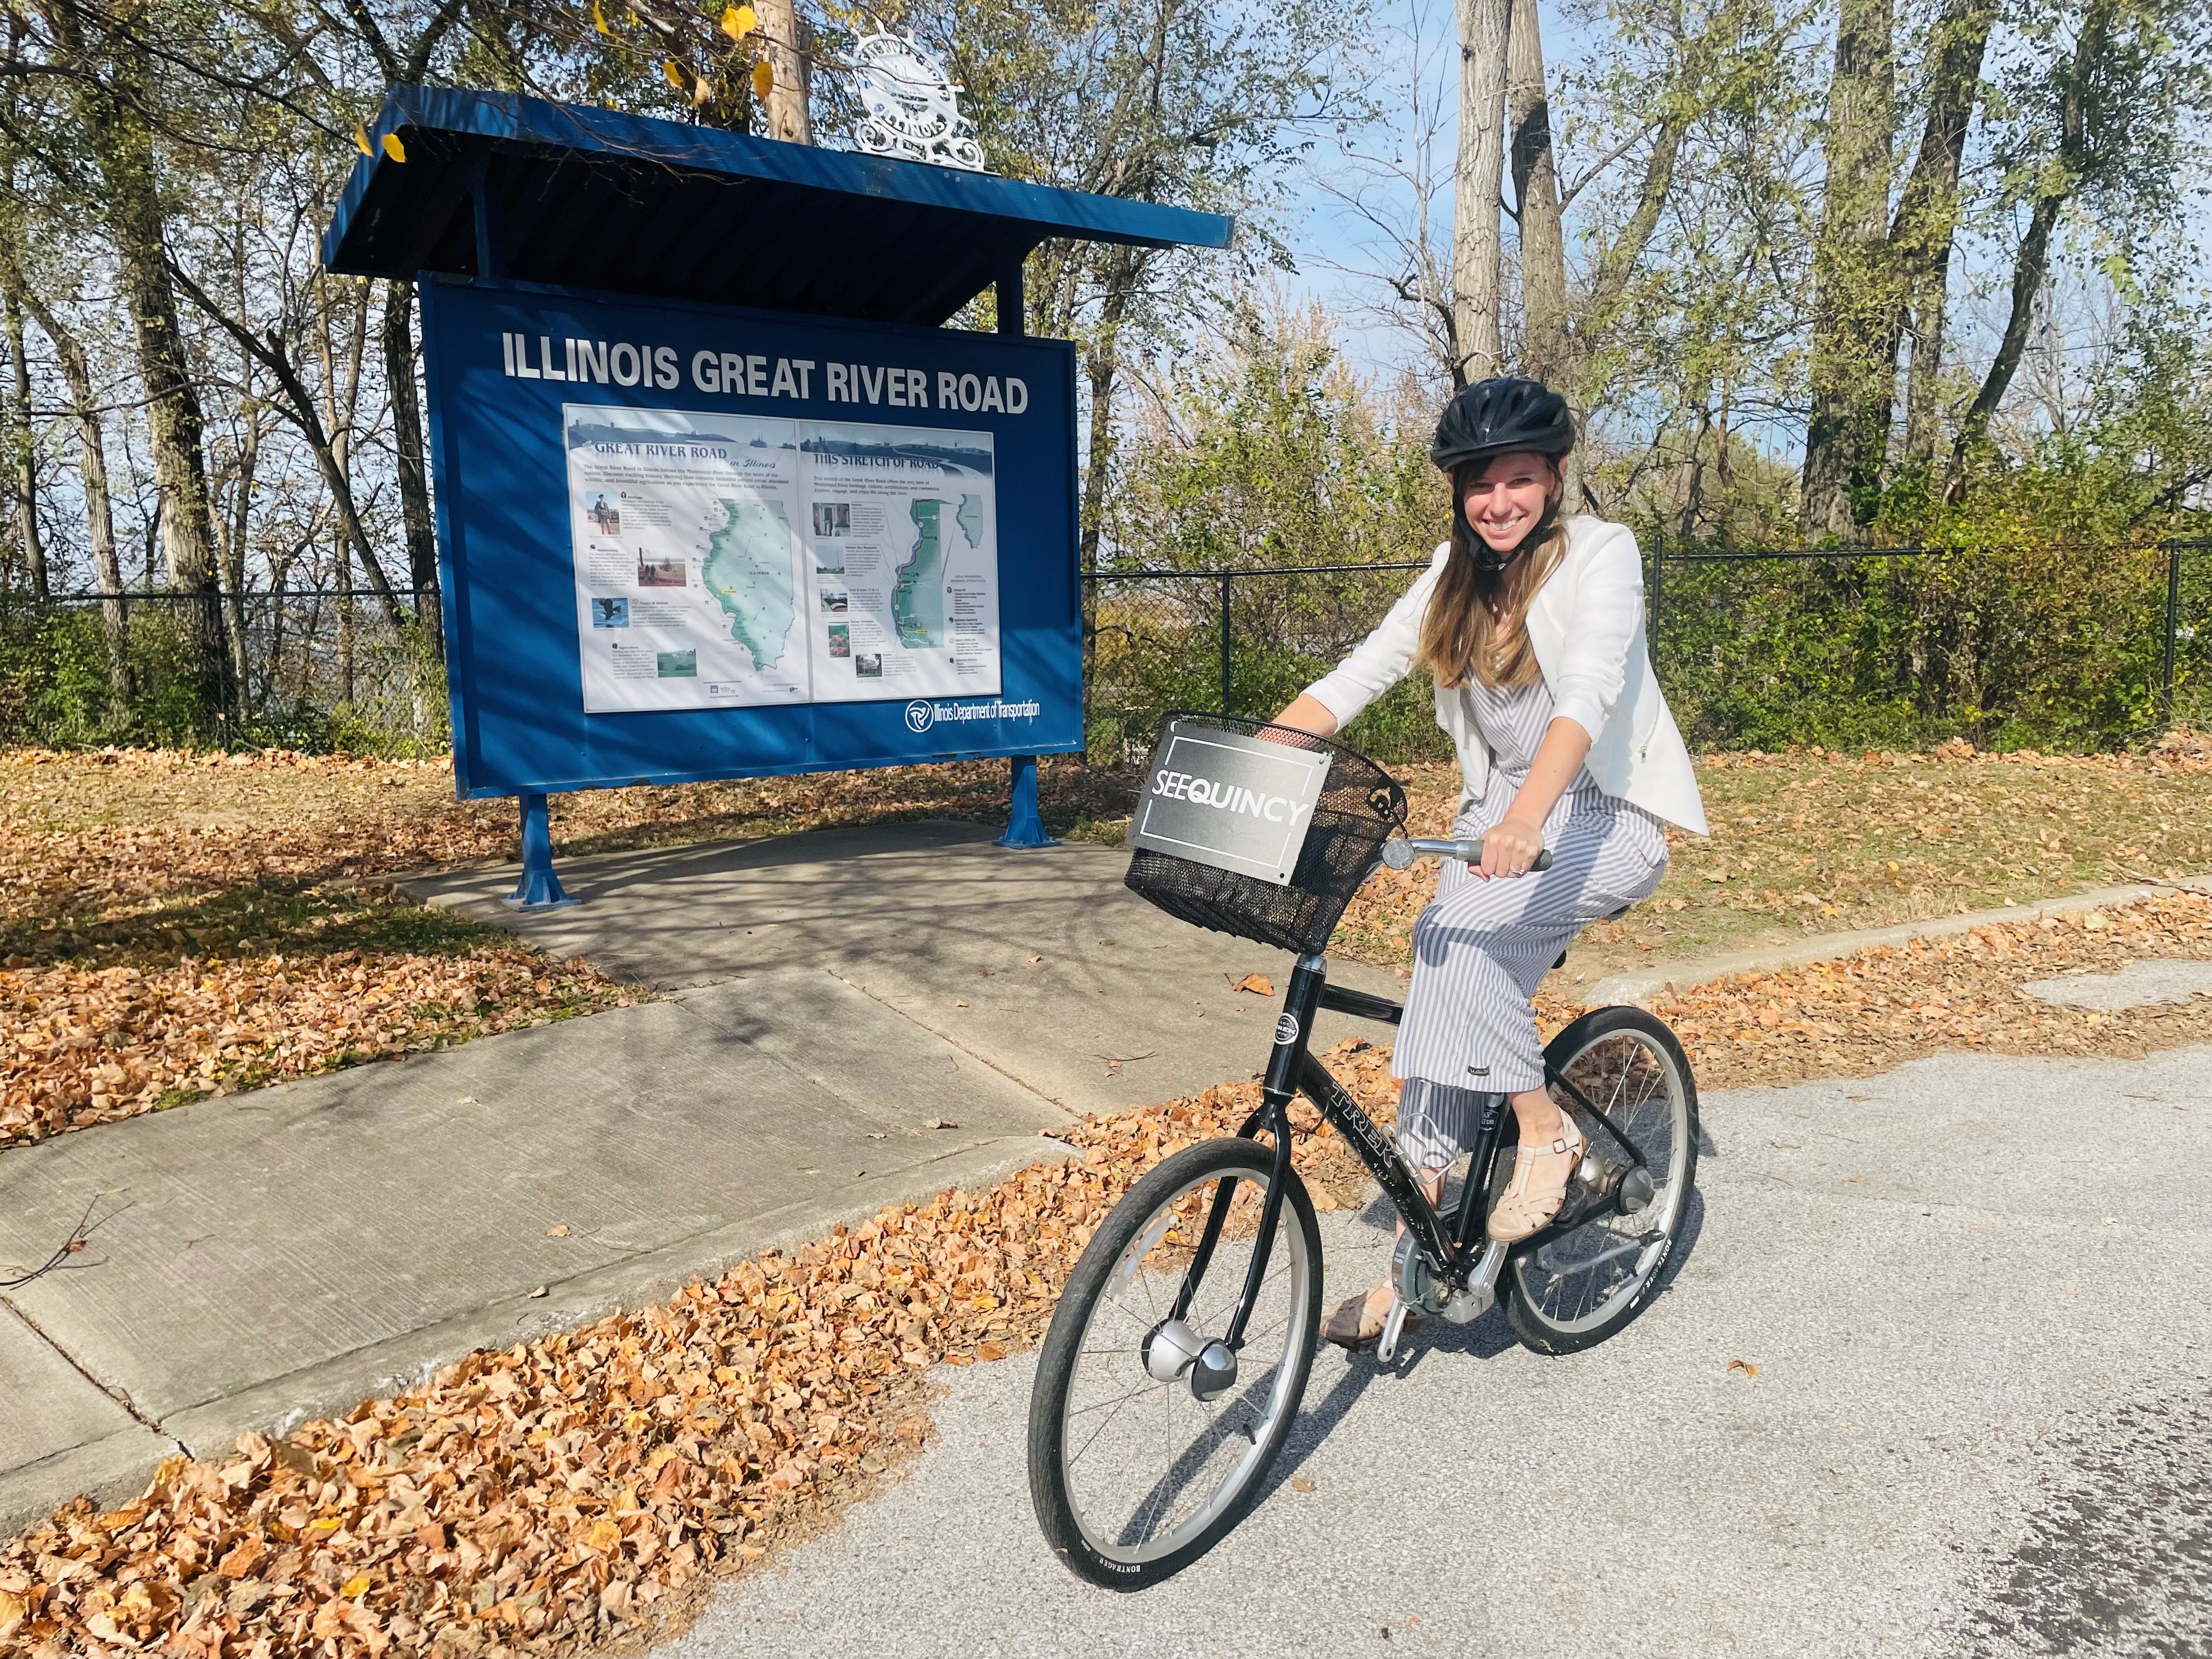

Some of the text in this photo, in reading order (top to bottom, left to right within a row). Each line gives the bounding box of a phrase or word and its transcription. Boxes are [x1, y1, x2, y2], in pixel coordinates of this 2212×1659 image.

[503, 332, 1029, 414] ILLINOIS GREAT RIVER ROAD
[595, 441, 727, 459] GREAT RIVER ROAD
[742, 459, 776, 469] Illinois
[814, 454, 939, 469] THIS STRETCH OF ROAD
[934, 699, 1040, 725] Illinois Department of Transportation
[1330, 1081, 1397, 1169] TREK
[1099, 1556, 1141, 1573] BONTRAGER
